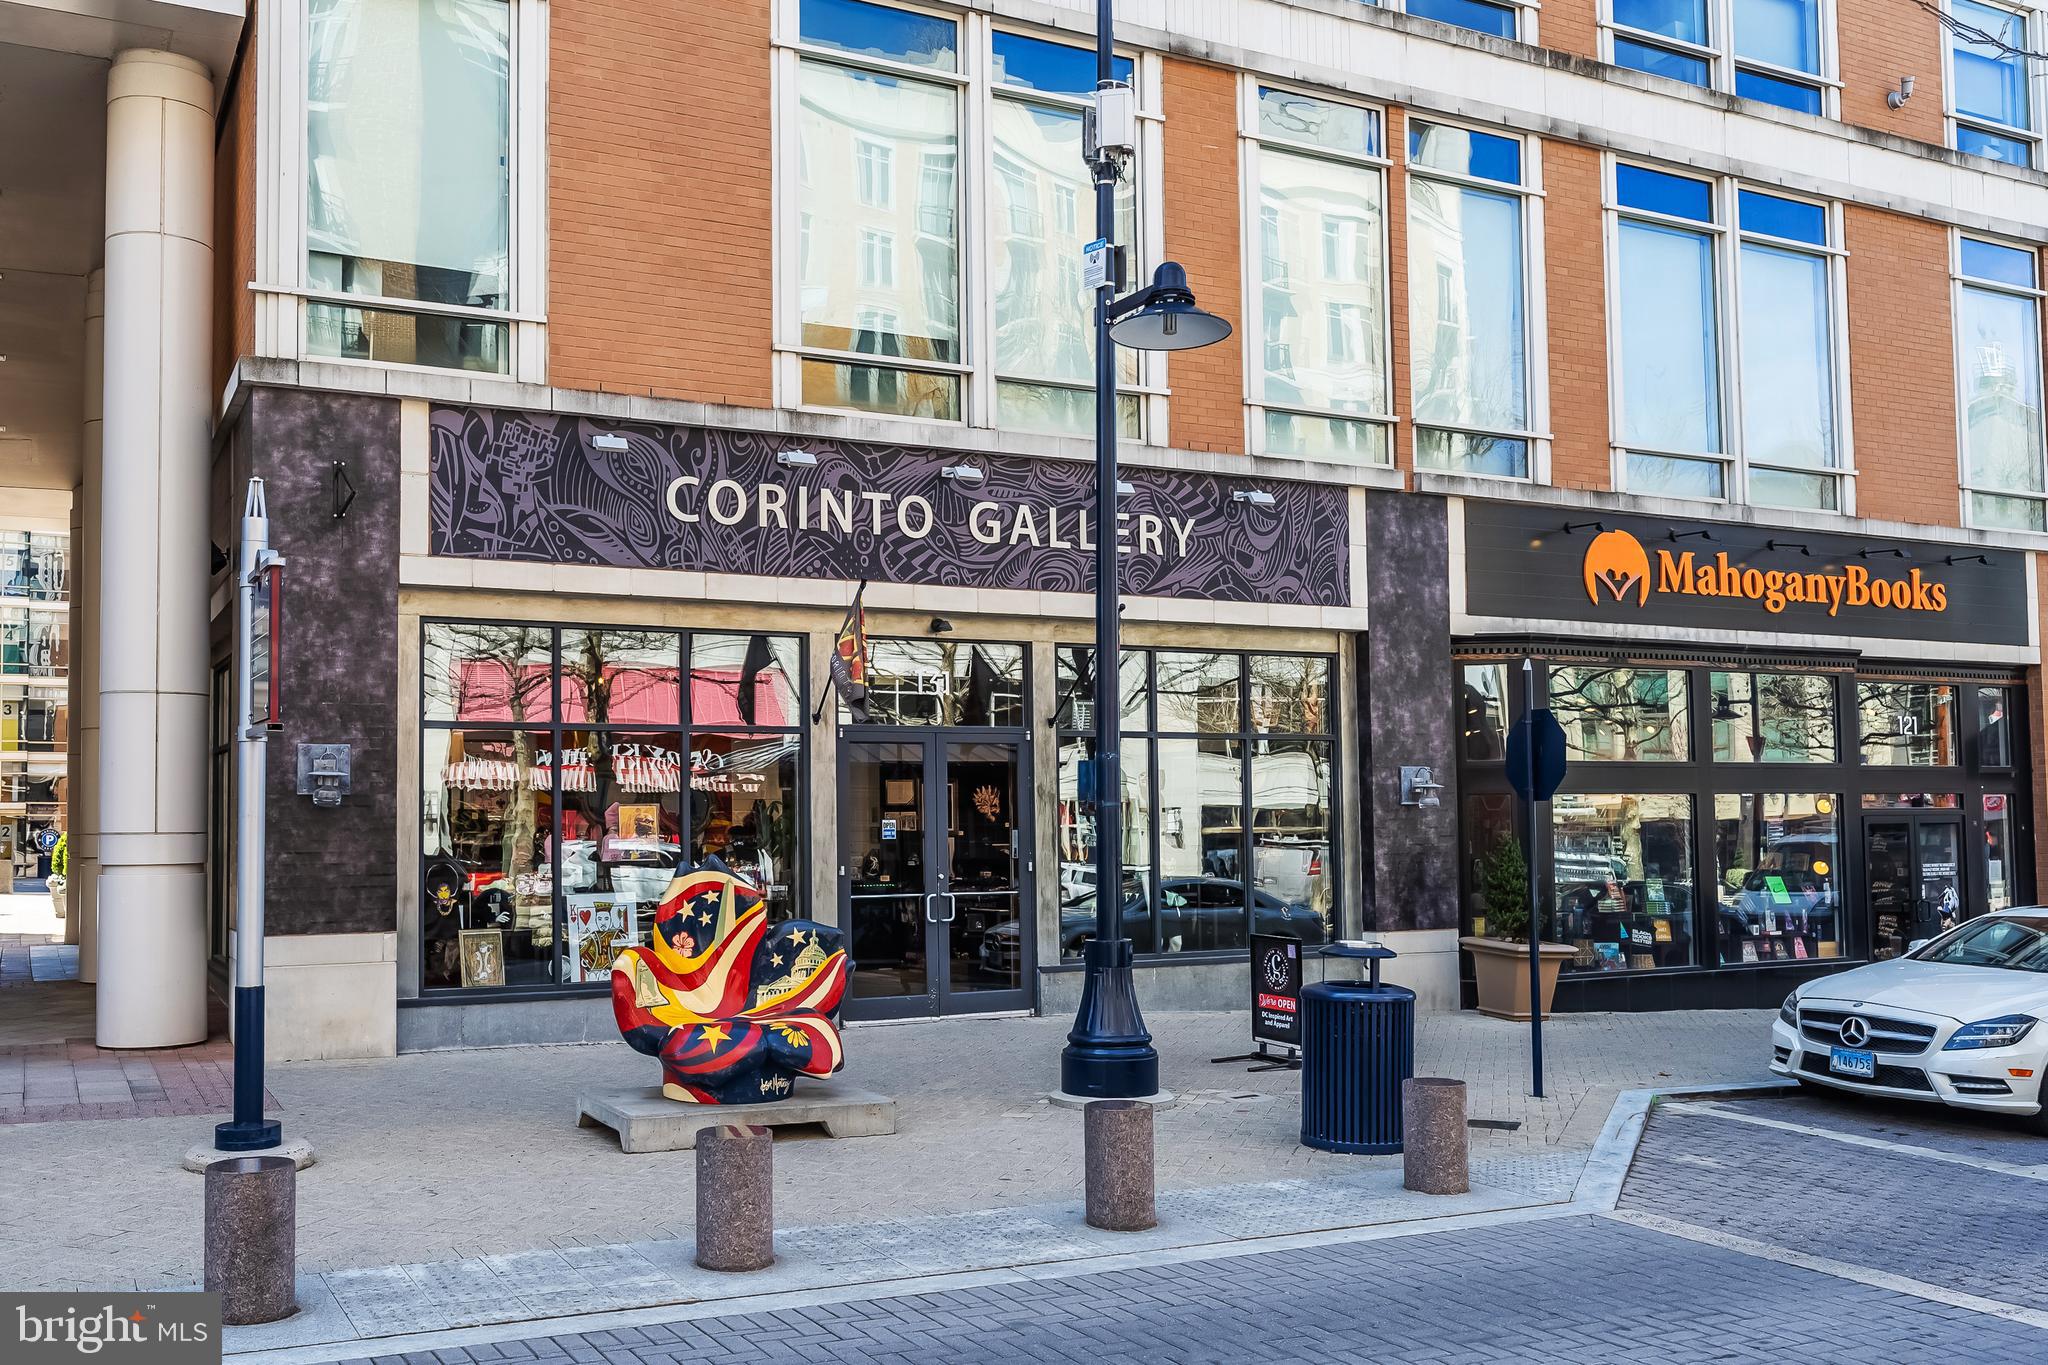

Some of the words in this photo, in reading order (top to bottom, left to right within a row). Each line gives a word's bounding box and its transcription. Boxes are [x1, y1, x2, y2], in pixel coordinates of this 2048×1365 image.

[666, 475, 934, 539] CORINTO
[968, 501, 1196, 557] GALLERY
[1655, 549, 1948, 617] MahoganyBooks
[5, 630, 13, 640] 4
[3, 704, 12, 715] 3
[1897, 715, 1918, 735] 121
[2, 826, 10, 837] 2
[46, 834, 55, 845] P
[569, 904, 577, 916] K
[1277, 998, 1296, 1011] OPEN
